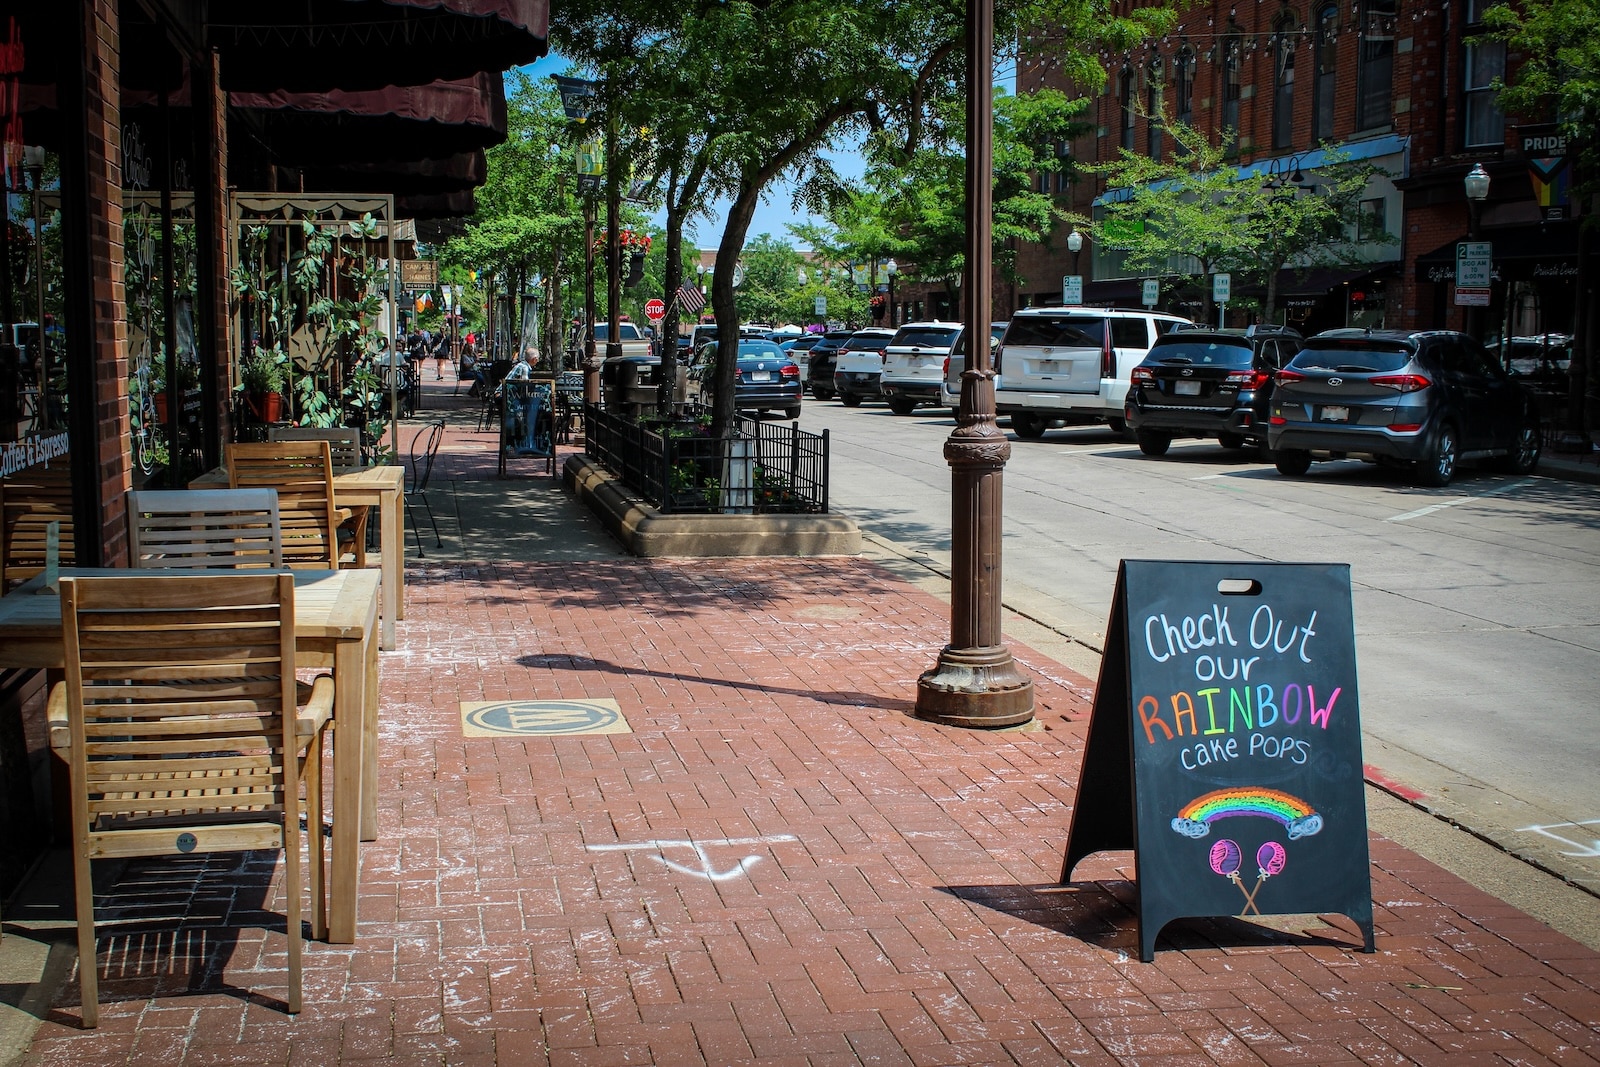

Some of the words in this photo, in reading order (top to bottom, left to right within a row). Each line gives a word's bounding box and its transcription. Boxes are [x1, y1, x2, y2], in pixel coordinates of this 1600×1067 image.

[1524, 136, 1566, 151] PRIDE
[1459, 247, 1466, 257] 2
[0, 441, 26, 478] offee
[27, 437, 34, 466] &
[35, 432, 69, 469] Espresso
[1144, 604, 1237, 663] Check
[1250, 604, 1316, 663] Out
[1195, 654, 1260, 681] our
[1137, 683, 1341, 744] RAINBOW
[1180, 734, 1240, 770] cake
